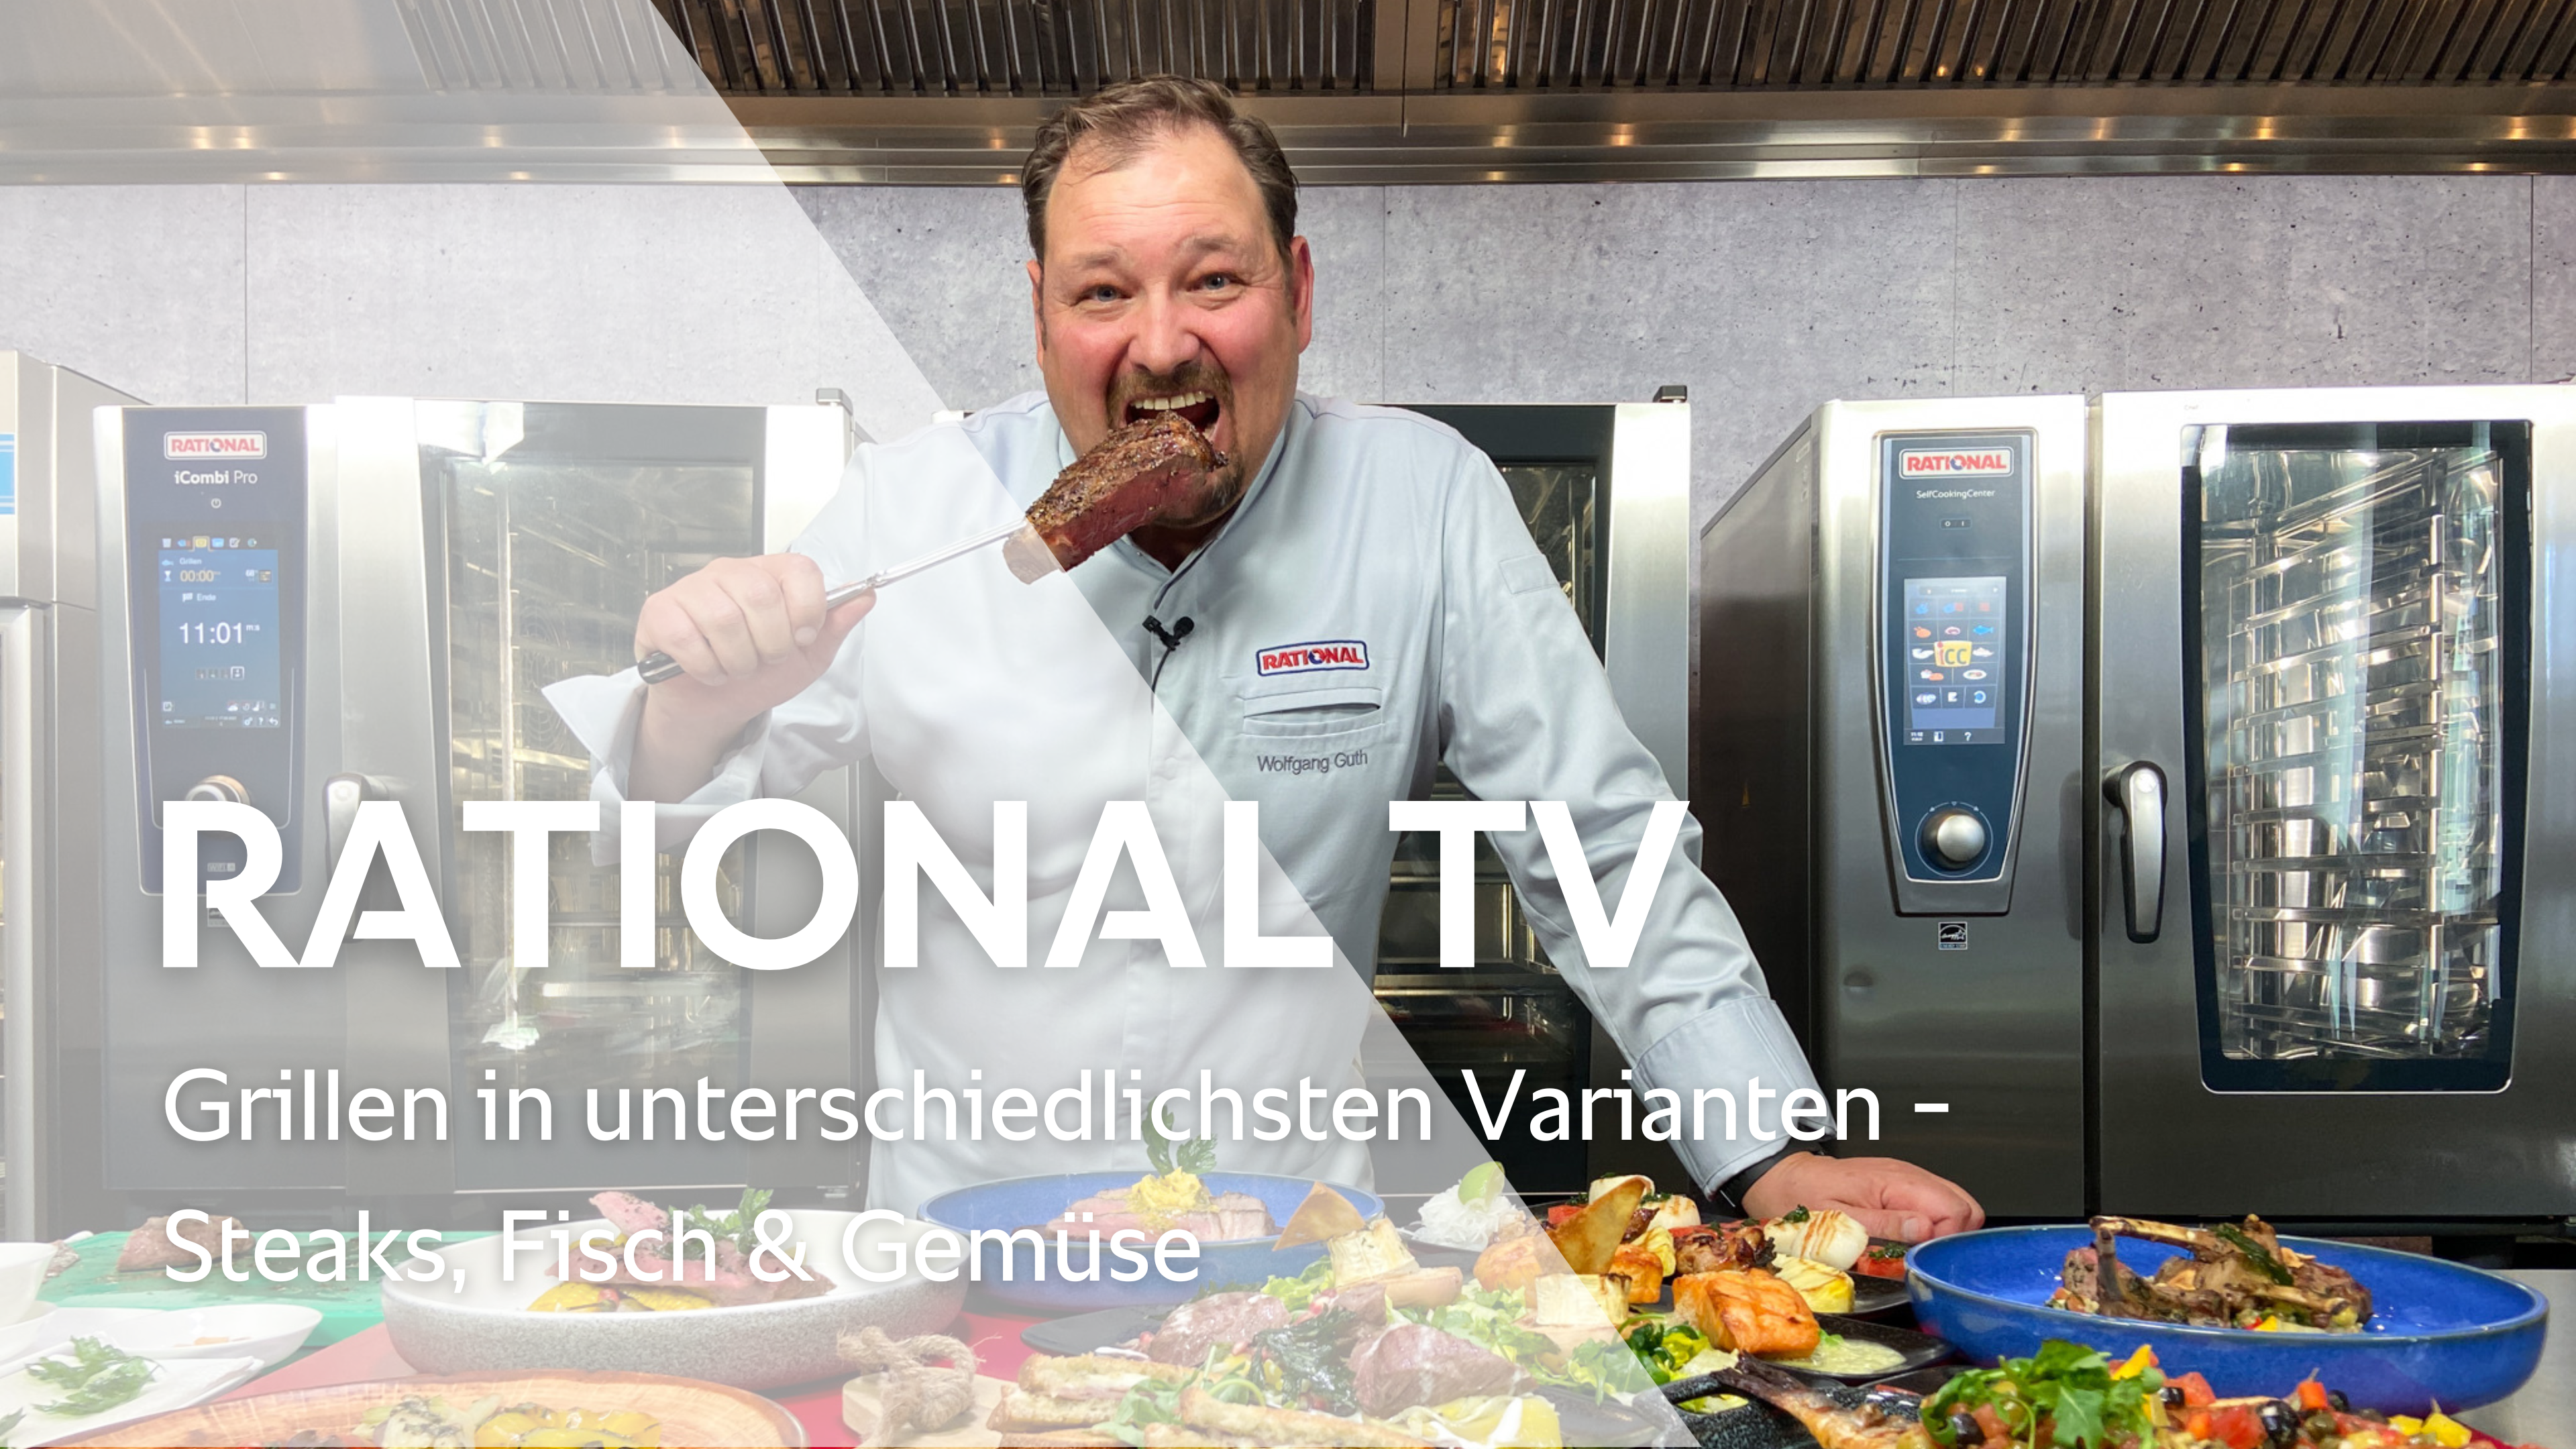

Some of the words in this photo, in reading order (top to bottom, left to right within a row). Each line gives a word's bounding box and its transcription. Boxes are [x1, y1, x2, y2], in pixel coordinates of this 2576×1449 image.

[171, 438, 261, 453] RATIONAL
[1907, 453, 2007, 472] RATIONAL
[174, 470, 229, 485] iCombi
[233, 471, 258, 484] Pro
[1916, 488, 1996, 500] SelfCookingCenter
[197, 592, 217, 602] Ende
[179, 621, 243, 645] 11:01
[1262, 646, 1364, 670] RATIONAL
[1256, 754, 1330, 775] Wolfgang
[1334, 749, 1368, 769] Guth
